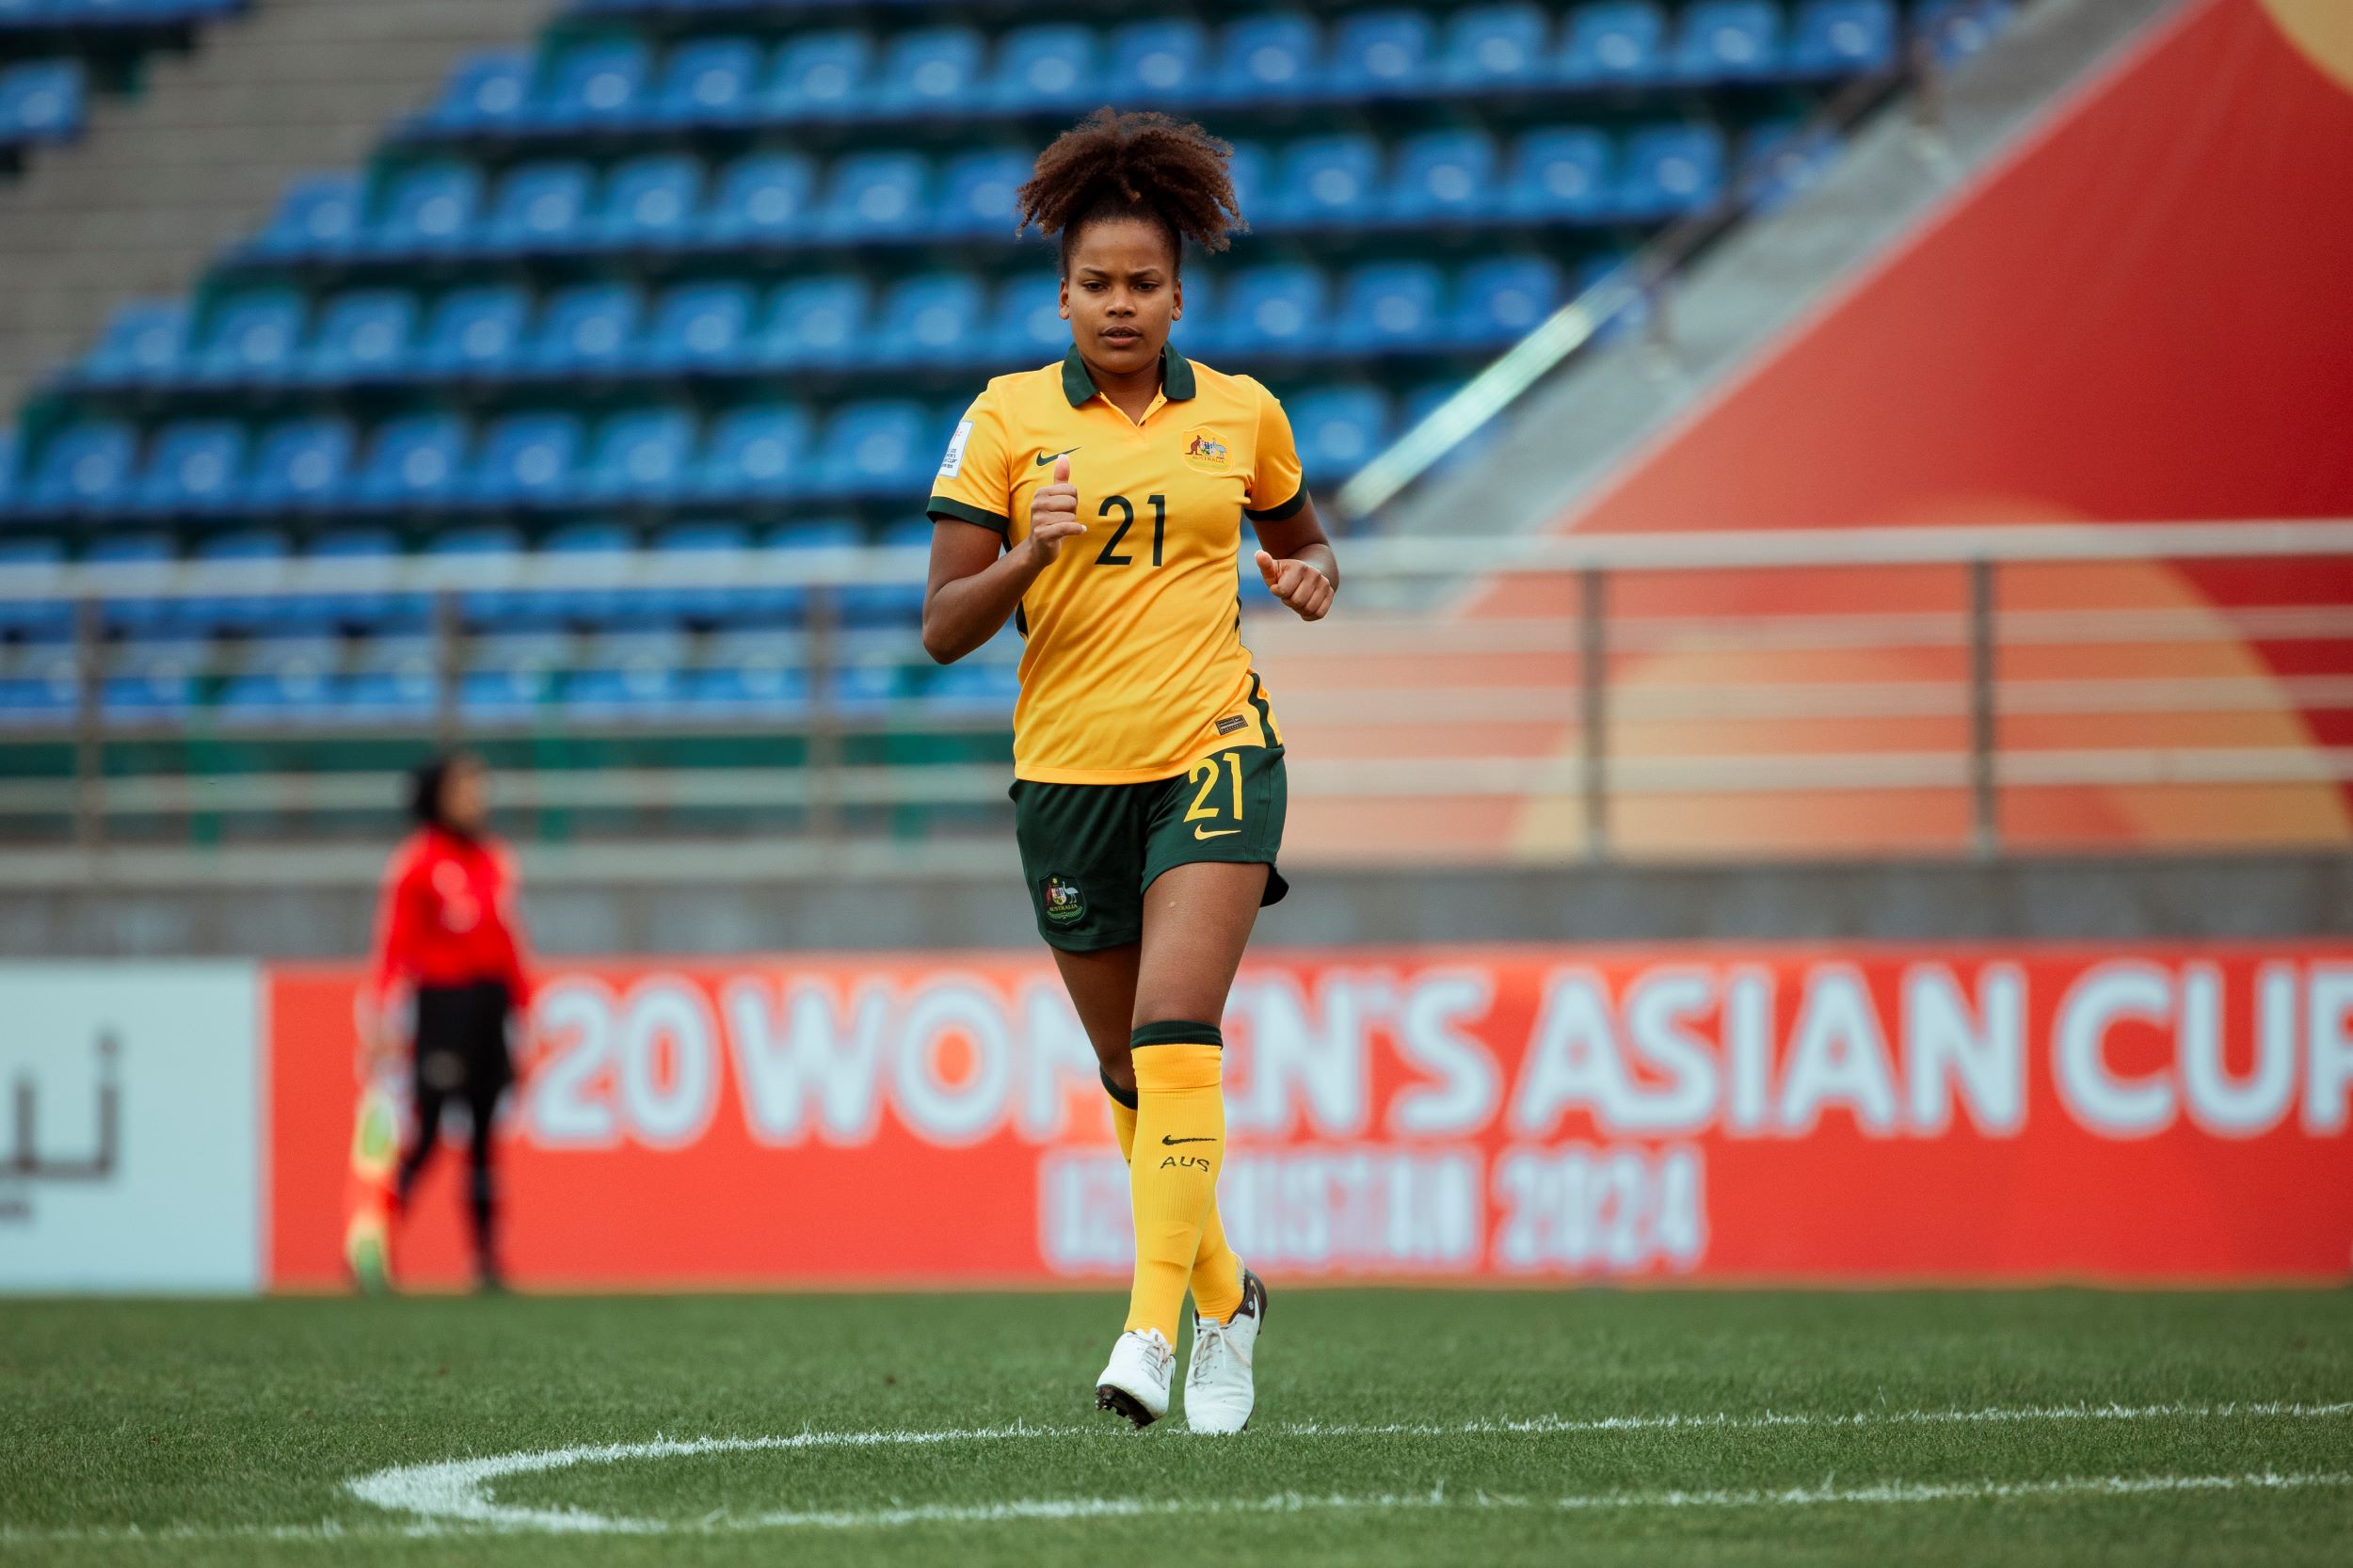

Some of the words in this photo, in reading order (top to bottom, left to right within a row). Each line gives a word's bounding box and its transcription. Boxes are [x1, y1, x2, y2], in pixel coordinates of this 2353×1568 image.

[1095, 494, 1165, 567] 21
[1183, 752, 1242, 823] 21
[1518, 967, 2024, 1137] ASIAN
[1160, 1156, 1209, 1172] AUS
